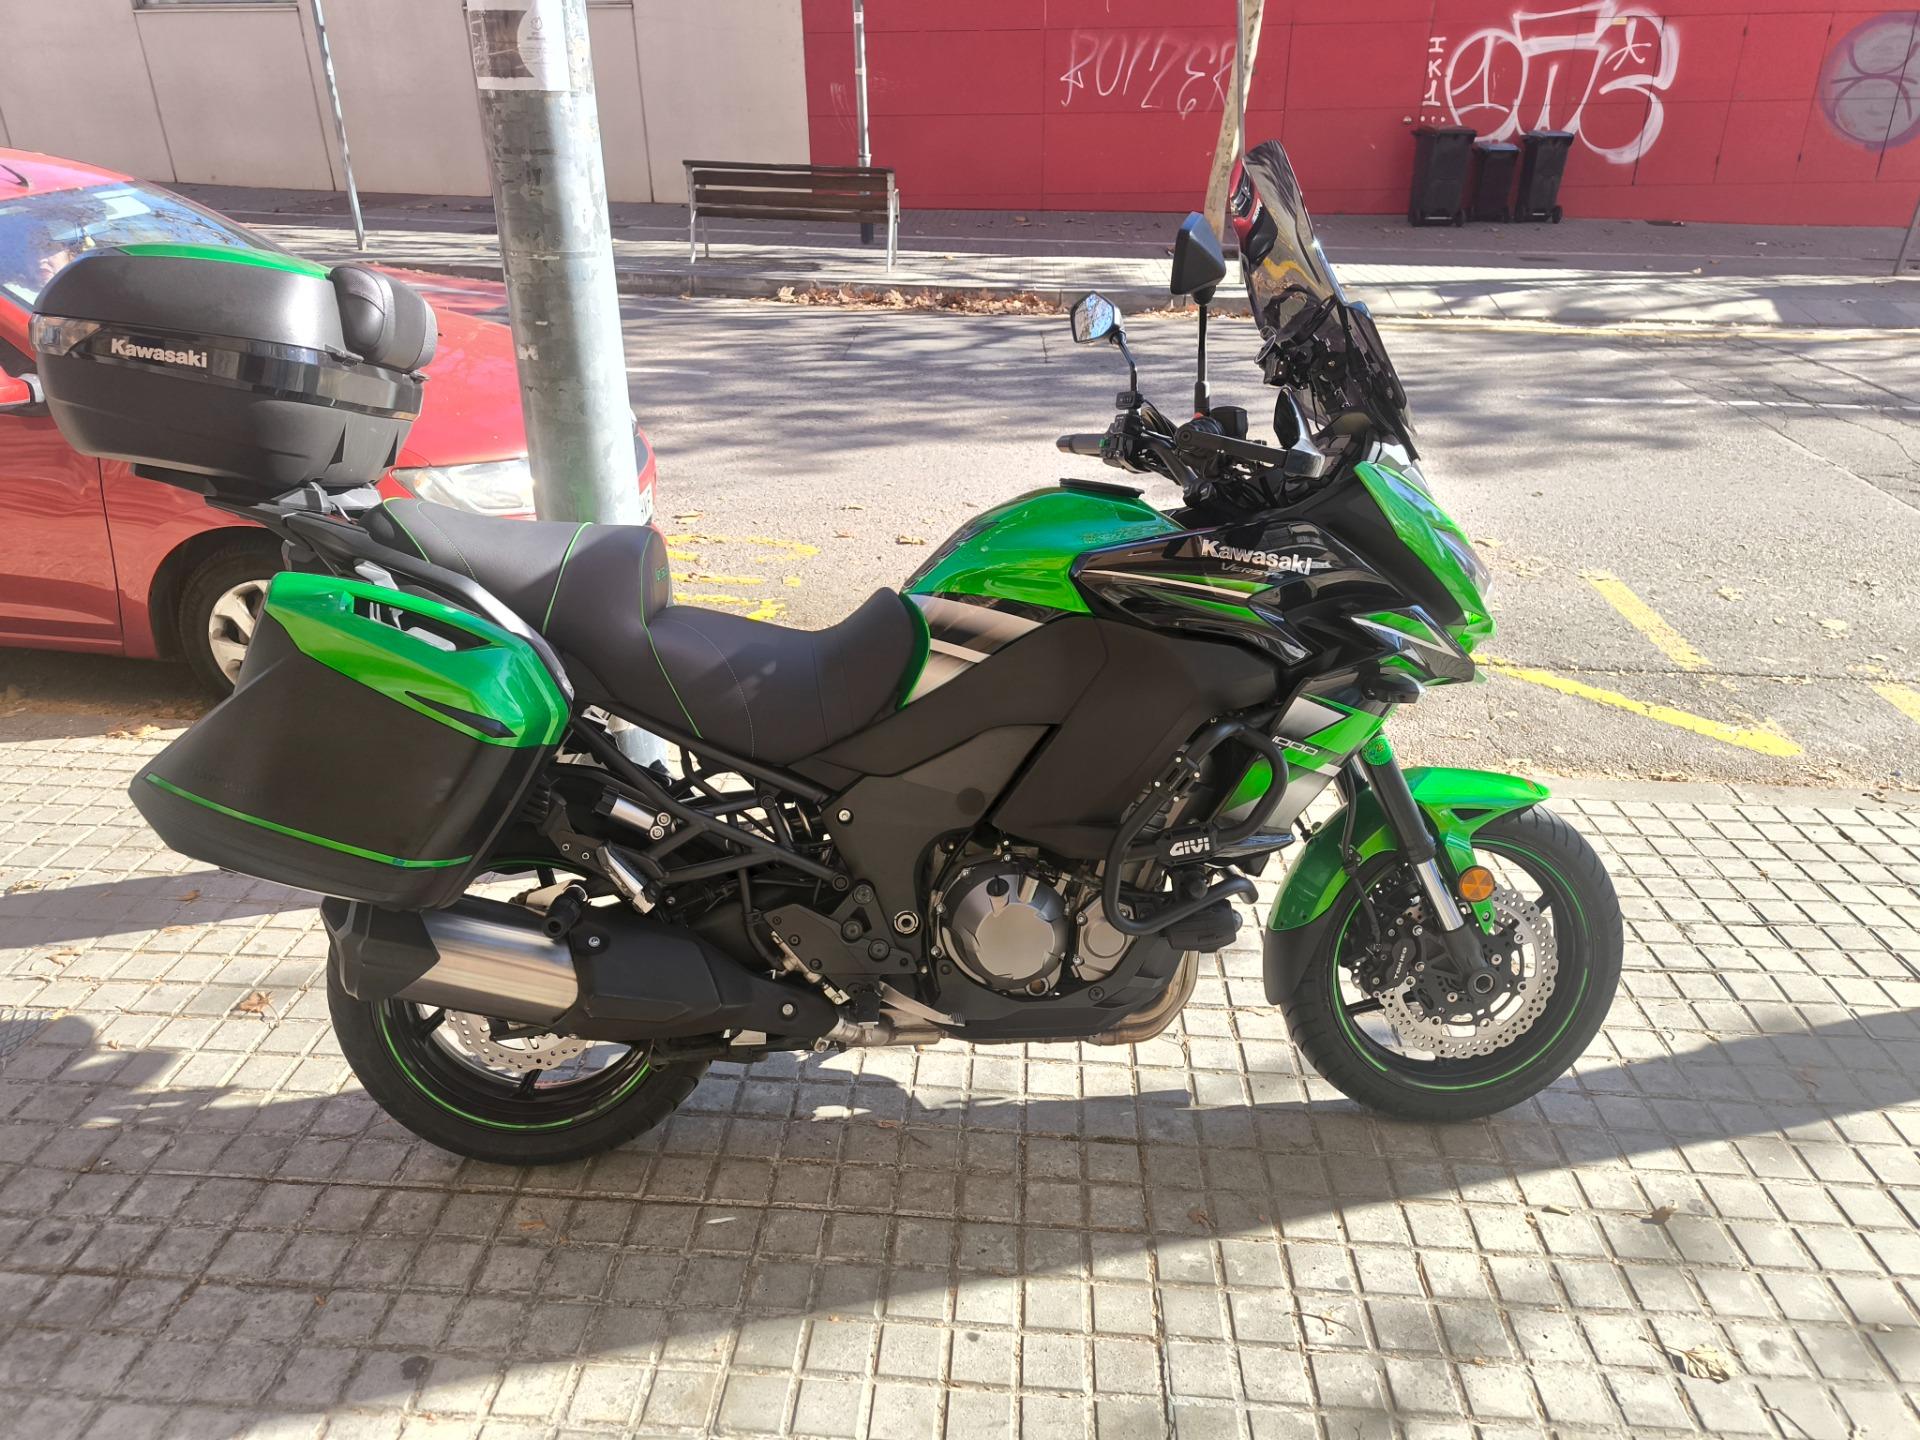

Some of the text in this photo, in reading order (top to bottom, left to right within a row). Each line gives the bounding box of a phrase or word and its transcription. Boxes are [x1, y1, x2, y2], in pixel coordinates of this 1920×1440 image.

[111, 337, 208, 369] Kawasaki
[1201, 539, 1313, 576] Kawasaki
[1271, 735, 1319, 756] 1000
[1169, 837, 1210, 857] GIVI
